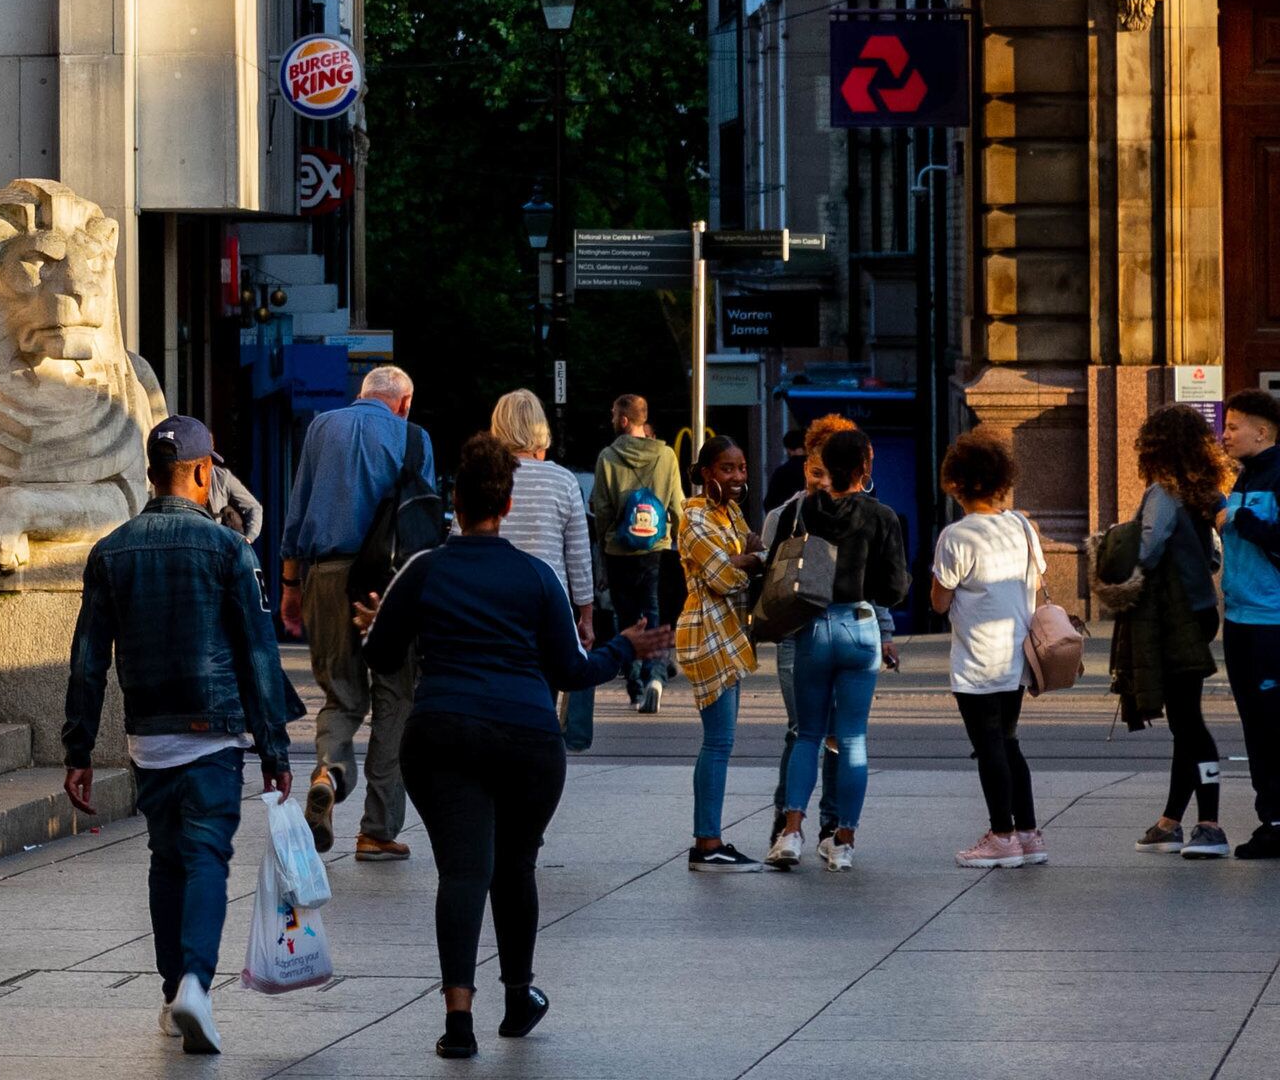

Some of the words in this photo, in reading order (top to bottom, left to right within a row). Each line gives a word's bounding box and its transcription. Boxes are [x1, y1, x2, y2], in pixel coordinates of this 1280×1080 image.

[288, 50, 351, 81] BURGER
[291, 64, 354, 102] KING
[578, 249, 611, 257] Nottingham
[611, 249, 651, 257] Contemporary
[726, 308, 773, 320] Warren
[730, 324, 769, 335] James
